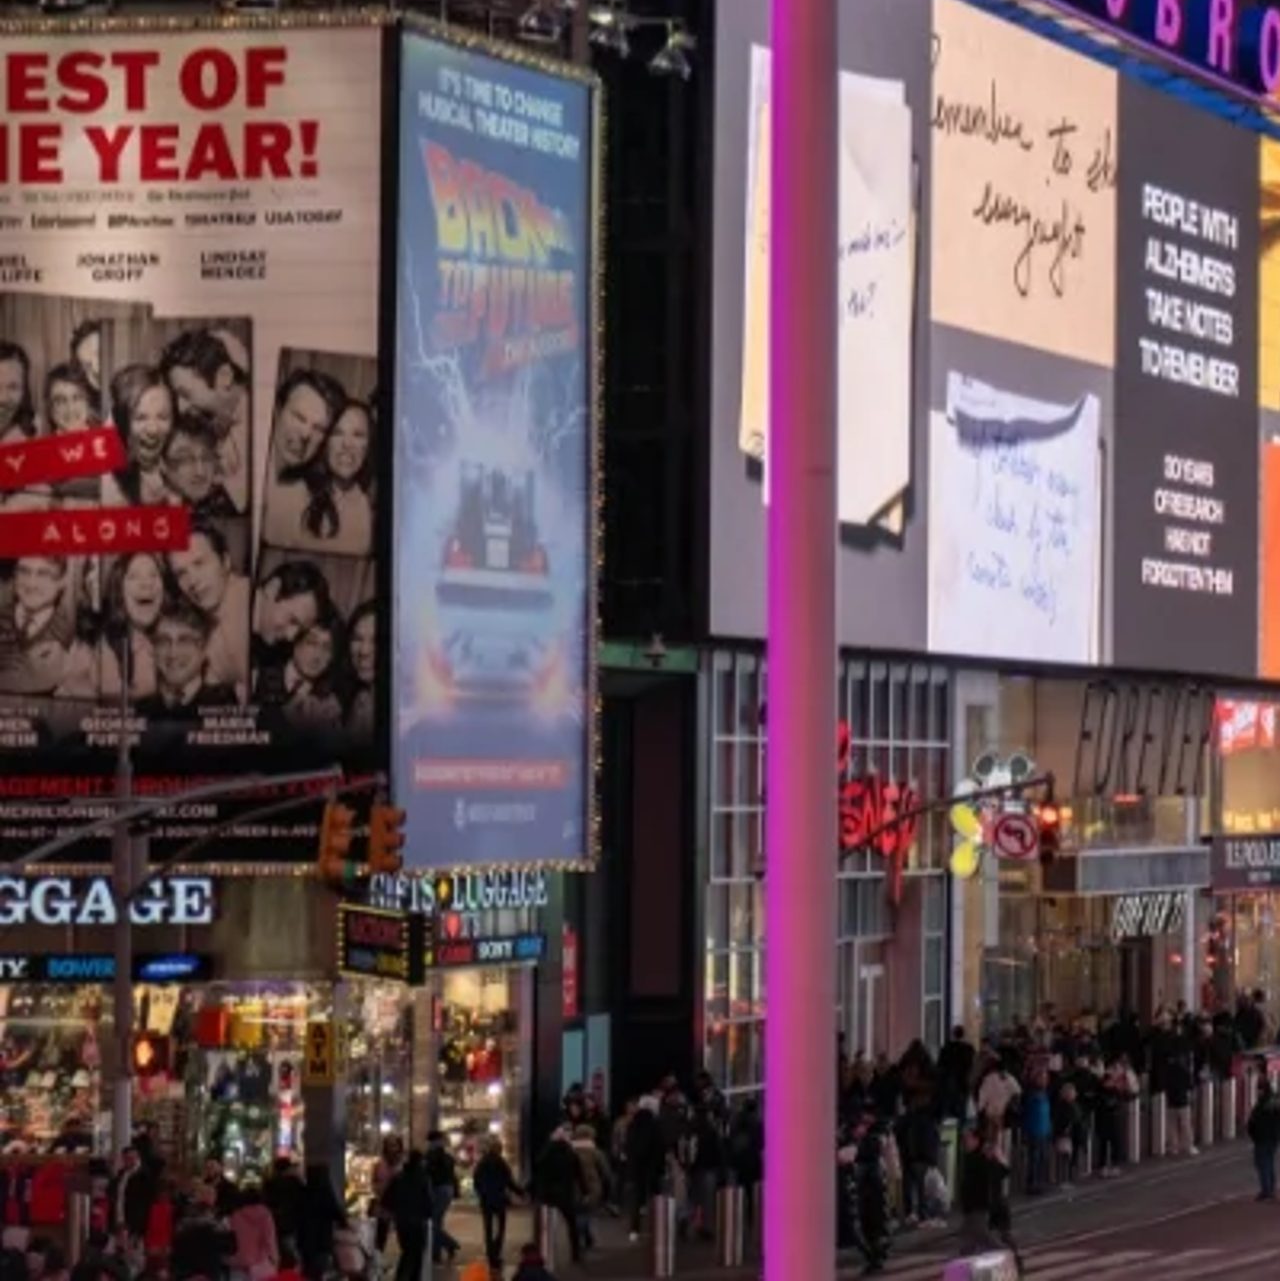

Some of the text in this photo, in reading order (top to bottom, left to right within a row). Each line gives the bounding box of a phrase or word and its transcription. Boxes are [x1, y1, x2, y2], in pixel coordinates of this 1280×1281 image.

[178, 46, 289, 109] OF
[465, 74, 492, 106] TIME
[495, 83, 513, 111] TO
[515, 88, 563, 126] CHANGE
[418, 90, 579, 161] MUSICAL THEATER HISTORY
[84, 120, 321, 183] YEAR!
[1142, 182, 1239, 251] PEOPLE WITH
[77, 253, 160, 267] JONATHAN
[200, 250, 268, 265] LINDSAY
[91, 269, 144, 282] GROFF
[200, 266, 268, 281] MENDEZ
[1144, 287, 1183, 332] TAKE
[1184, 298, 1233, 346] NOTES
[1138, 336, 1162, 377] TO
[61, 439, 110, 465] WE
[41, 517, 172, 544] ALONG
[80, 717, 257, 733] GEORGE MARIA
[186, 731, 271, 745] FRIEDMAN
[369, 868, 549, 912] GIFTS LUGGAGE
[478, 940, 513, 959] SONY
[311, 1023, 328, 1077] ATM
